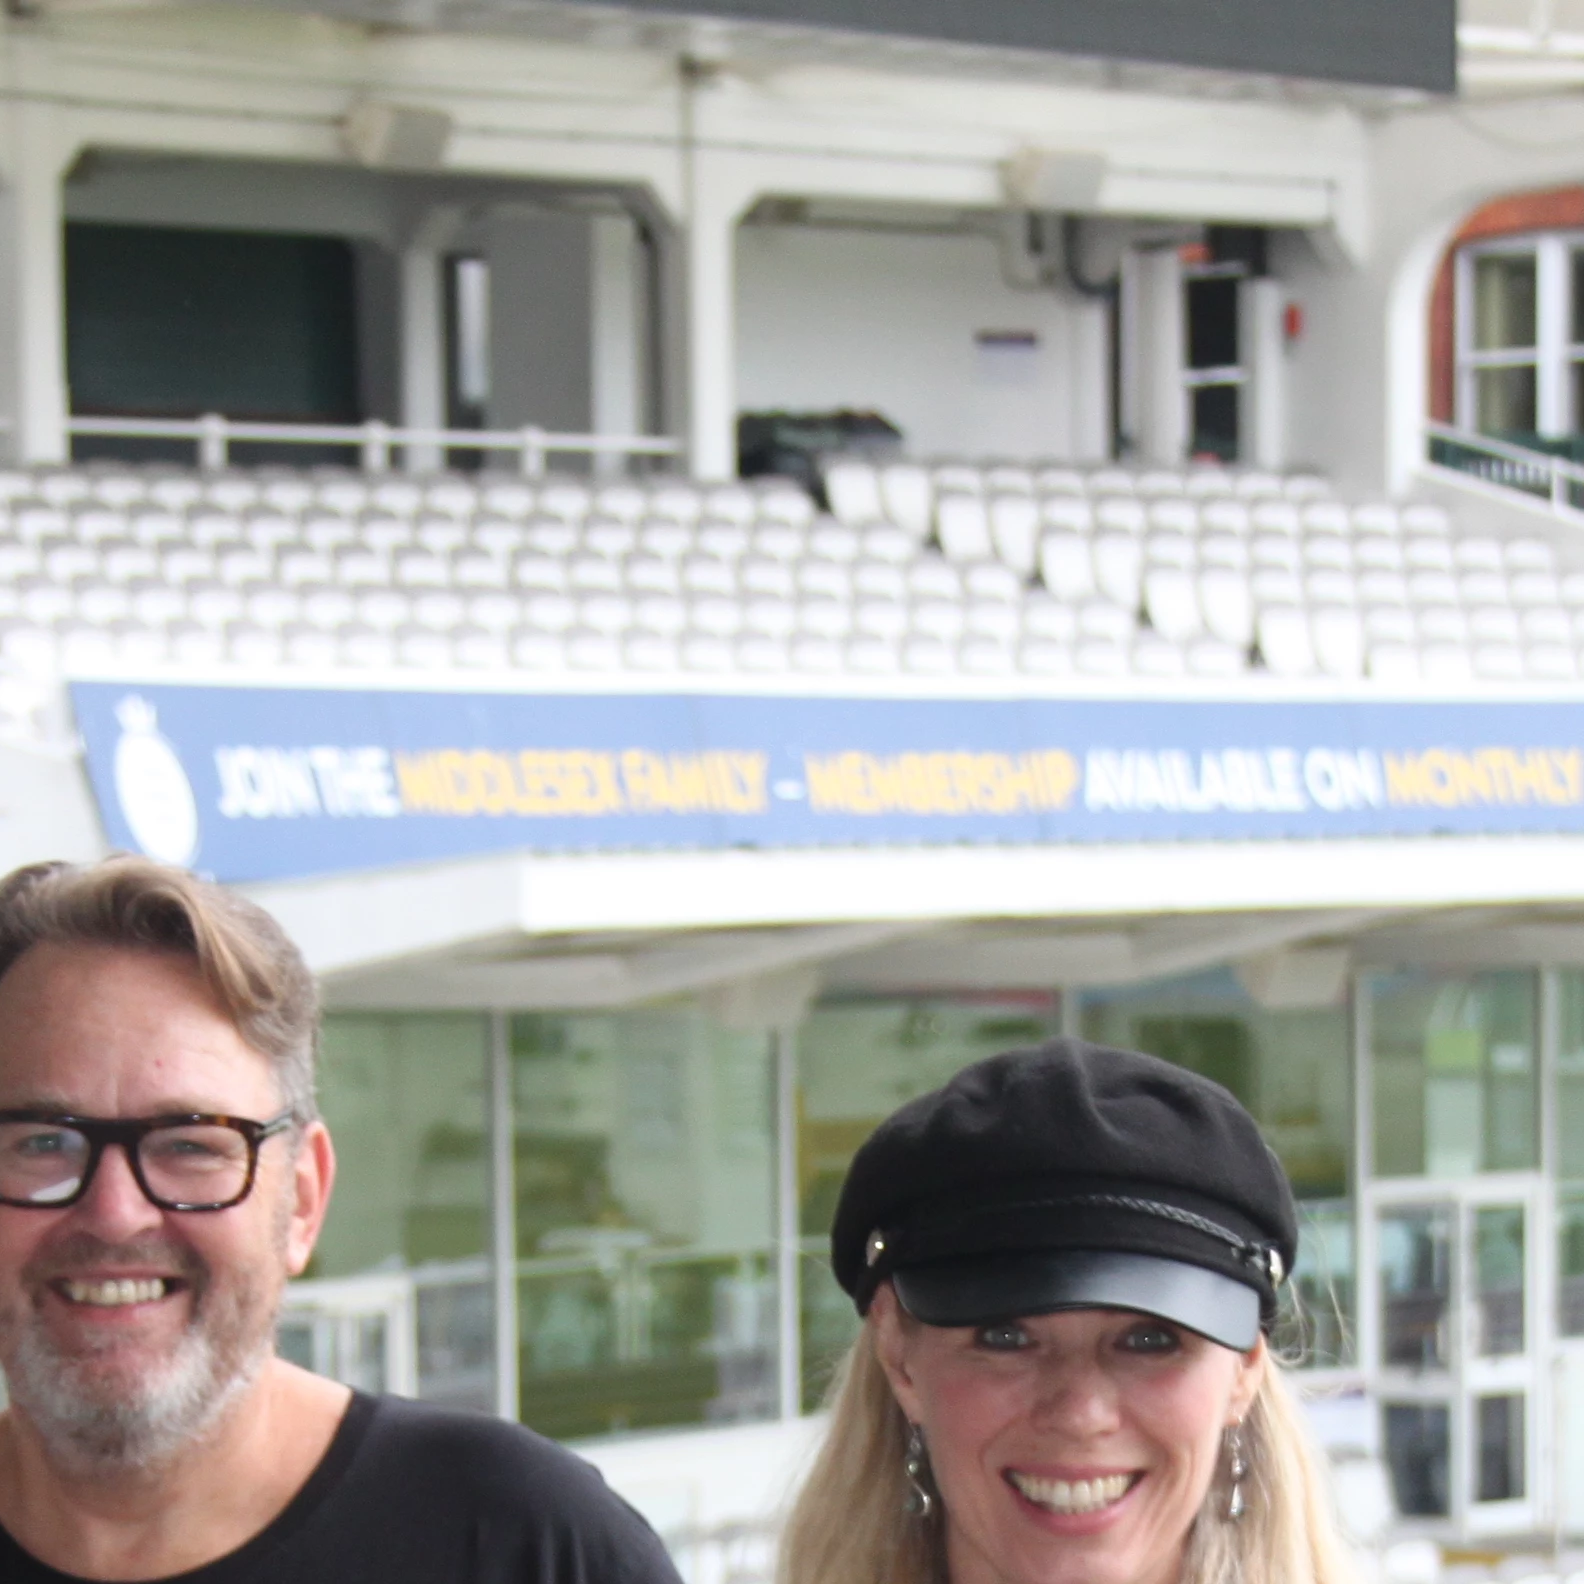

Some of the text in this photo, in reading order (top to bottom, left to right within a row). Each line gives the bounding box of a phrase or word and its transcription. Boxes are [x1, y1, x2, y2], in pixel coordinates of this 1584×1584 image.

[216, 745, 315, 818] JOIN
[308, 745, 403, 818] THE
[393, 748, 617, 816] MIDDLESEX
[619, 748, 768, 816] FAMILY
[806, 748, 1080, 815] MEMBERSHIP
[1084, 746, 1306, 812] AVAILABLE
[1302, 746, 1385, 811] ON
